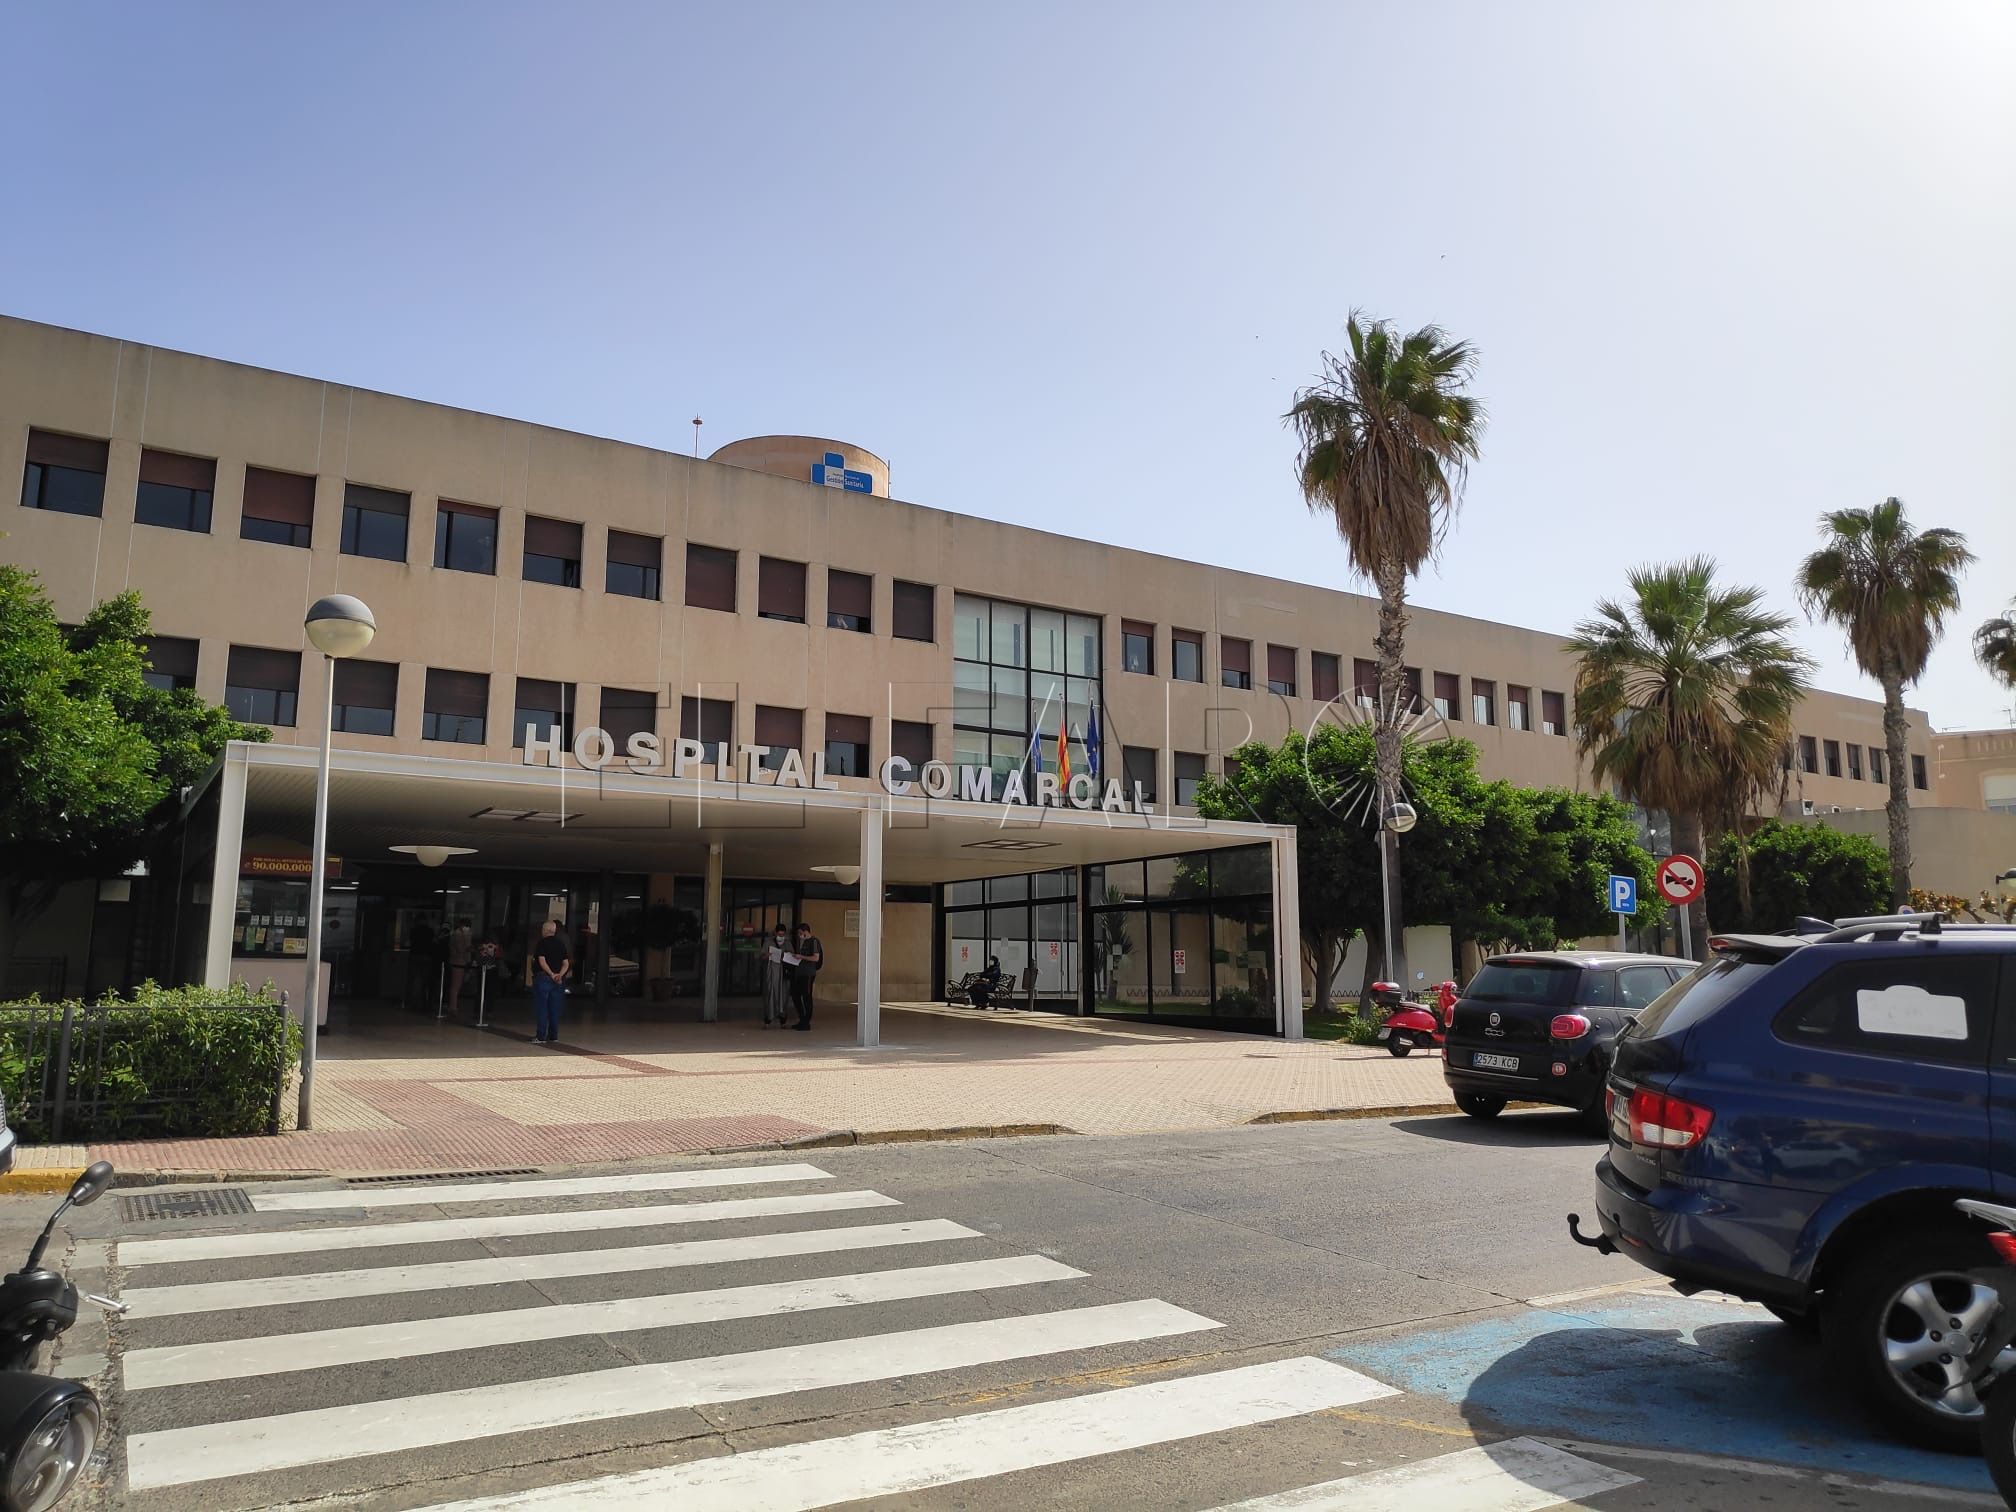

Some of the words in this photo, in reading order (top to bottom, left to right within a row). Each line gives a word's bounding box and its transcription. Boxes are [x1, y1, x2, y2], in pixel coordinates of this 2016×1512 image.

[523, 722, 839, 791] HOSPITAL
[880, 755, 1154, 814] COMARCAL
[1615, 880, 1631, 908] P
[1477, 1054, 1498, 1066] 2573
[1502, 1057, 1518, 1069] KCB
